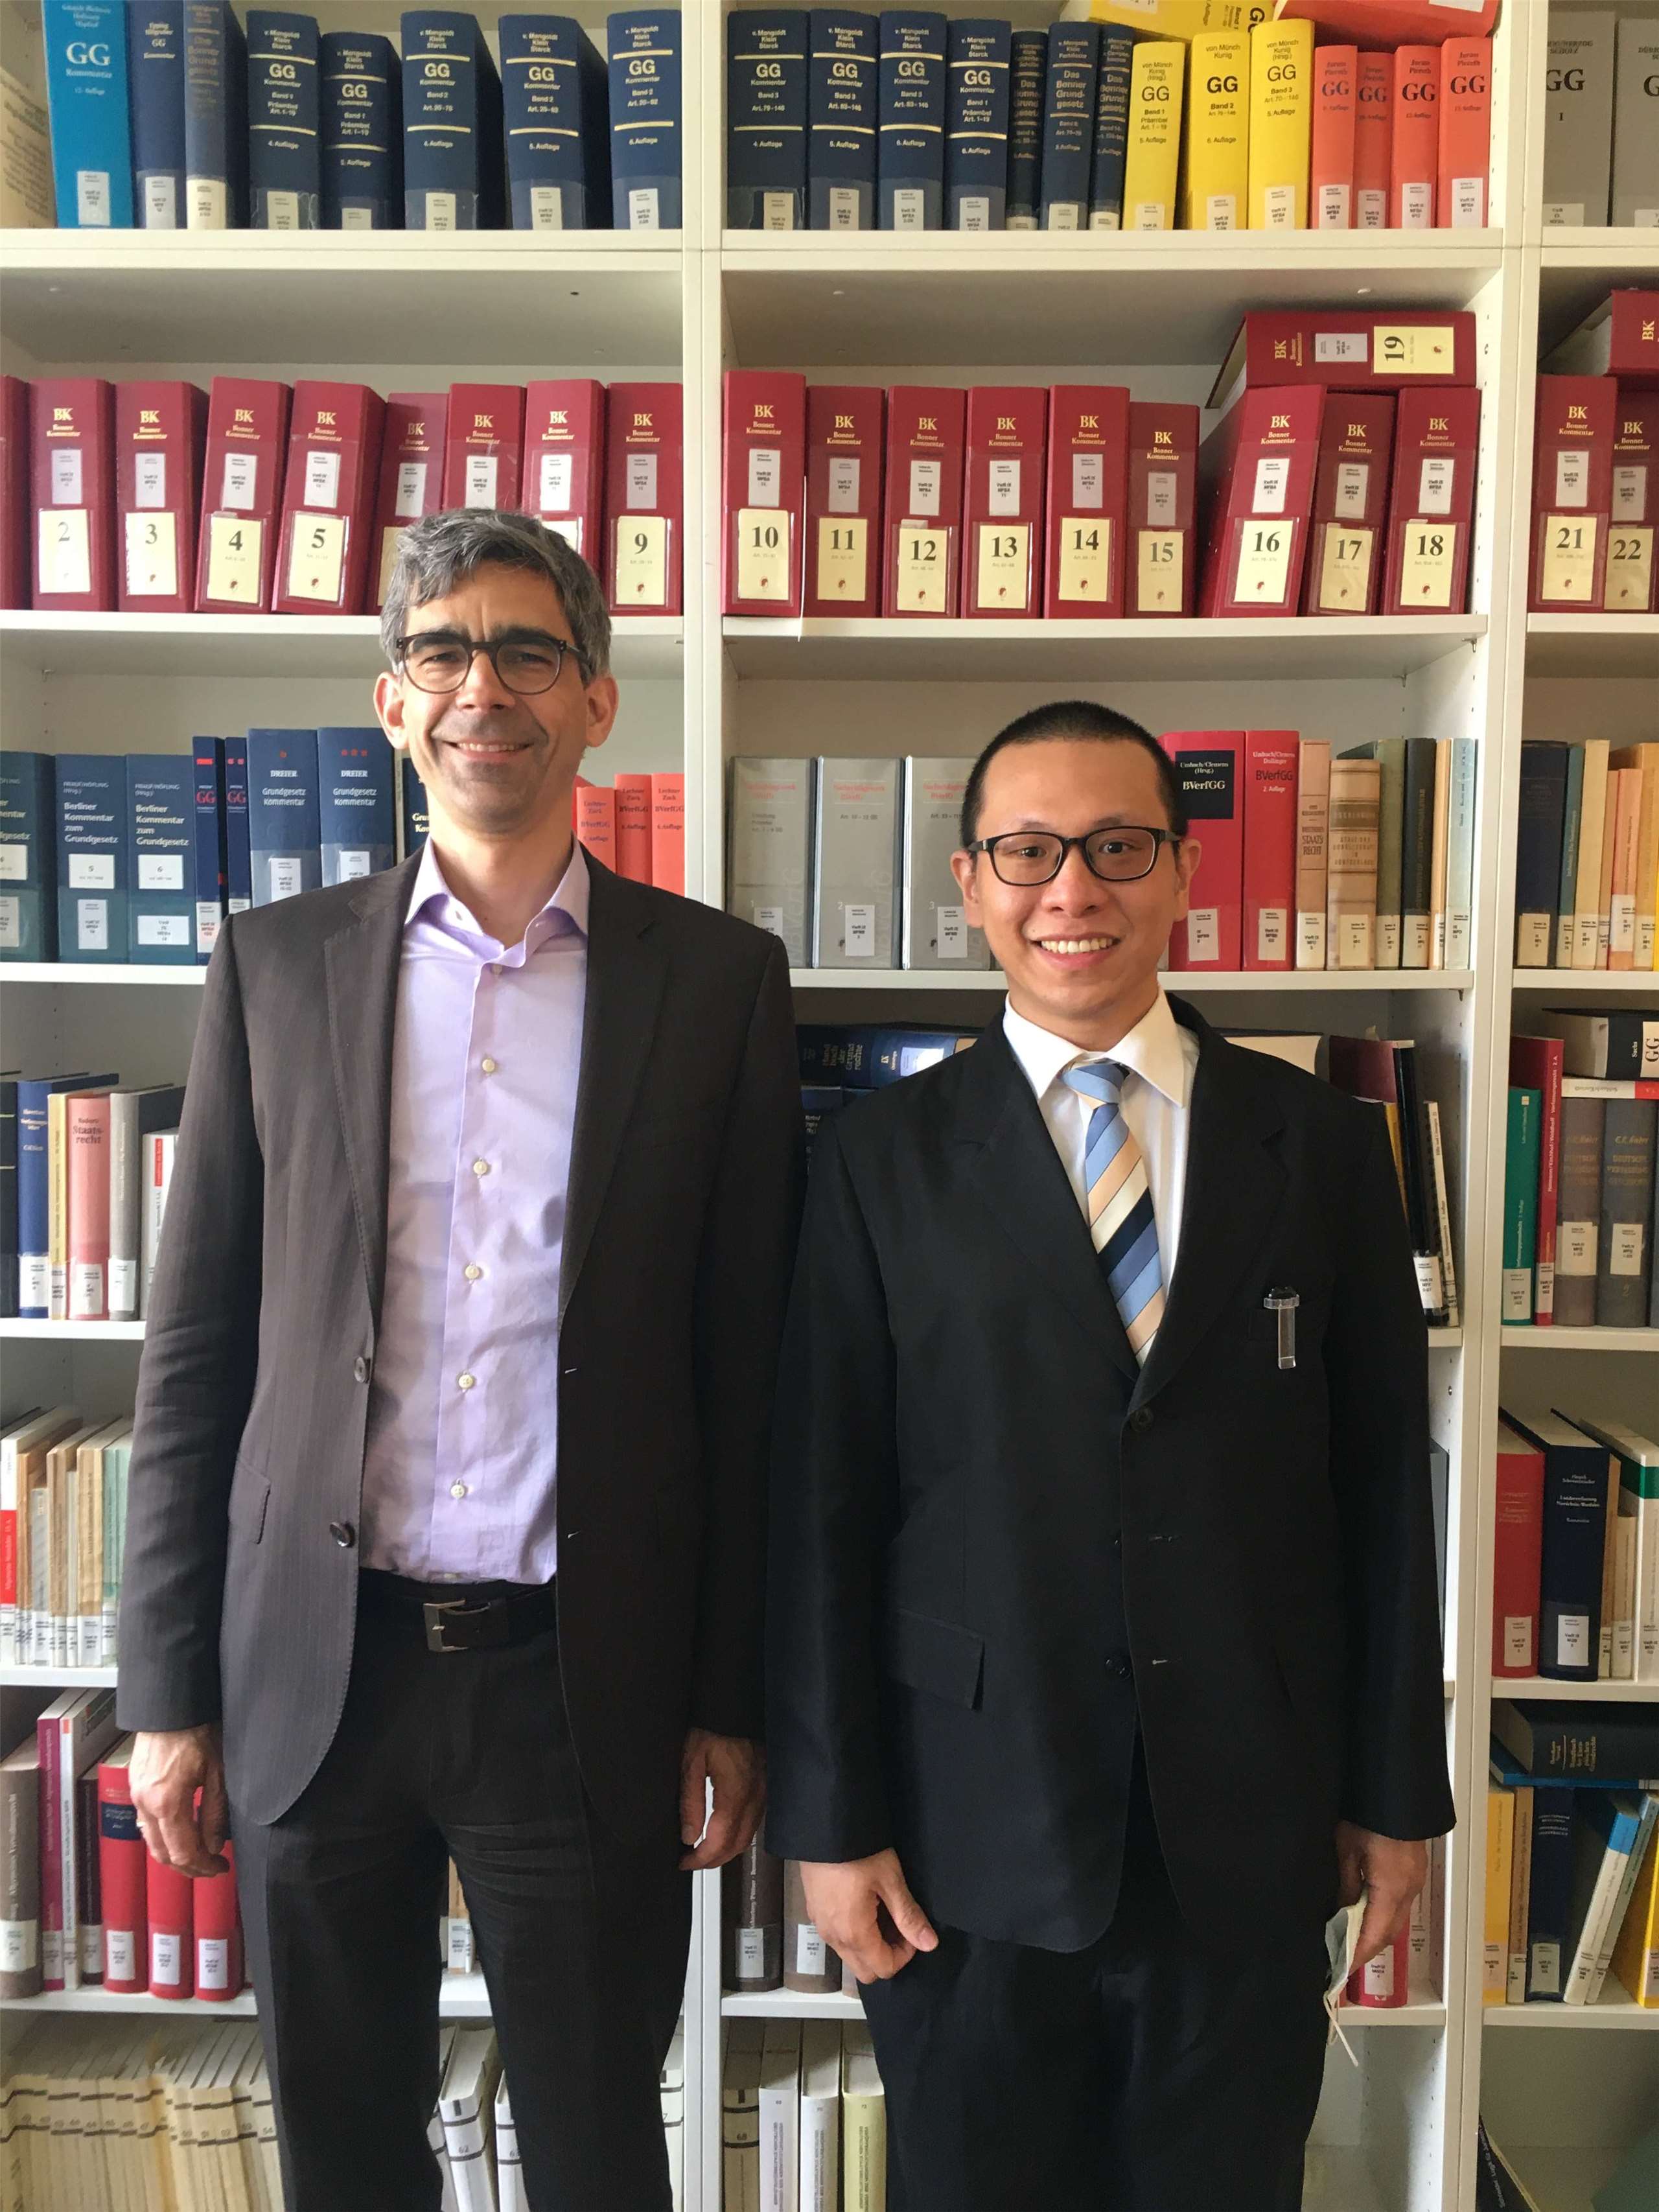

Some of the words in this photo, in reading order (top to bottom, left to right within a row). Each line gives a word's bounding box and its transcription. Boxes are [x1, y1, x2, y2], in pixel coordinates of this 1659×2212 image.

[151, 39, 167, 47] GG
[66, 41, 111, 66] GG
[269, 64, 296, 79] GG
[424, 63, 450, 78] GG
[528, 67, 555, 82] GG
[629, 60, 656, 75] GG
[756, 64, 782, 78] GG
[832, 63, 858, 78] GG
[898, 62, 925, 76] GG
[1063, 70, 1080, 78] Das
[1267, 64, 1296, 82] GG
[827, 78, 863, 87] Kommentar
[964, 70, 991, 85] GG
[1207, 76, 1238, 93] GG
[342, 84, 367, 99] GG
[1322, 80, 1349, 97] GG
[1450, 75, 1485, 95] GG
[1142, 86, 1170, 101] GG
[1358, 86, 1387, 102] GG
[1402, 83, 1436, 102] GG
[1642, 320, 1655, 341] BK
[1275, 340, 1286, 359] BK
[1384, 336, 1405, 362] 19
[52, 408, 73, 421] BK
[140, 410, 161, 423] BK
[234, 409, 255, 423] BK
[316, 411, 336, 425] BK
[549, 410, 569, 424] BK
[754, 404, 774, 418] BK
[1568, 406, 1588, 419] BK
[474, 414, 494, 428] BK
[633, 413, 653, 426] BK
[835, 415, 855, 428] BK
[918, 417, 938, 430] BK
[997, 417, 1016, 430] BK
[1080, 415, 1099, 428] BK
[1270, 415, 1290, 428] BK
[1429, 418, 1449, 430] BK
[407, 422, 425, 436] BK
[746, 427, 782, 436] Kommentar
[1347, 424, 1367, 437] BK
[1623, 421, 1643, 434] BK
[133, 432, 168, 440] Kommentar
[226, 432, 261, 440] Kommentar
[307, 433, 343, 442] Kommentar
[1154, 432, 1172, 444] BK
[1260, 437, 1297, 445] Kommentar
[58, 521, 70, 542] 2
[145, 523, 157, 544] 3
[312, 528, 325, 549] 5
[752, 526, 779, 548] 10
[1556, 527, 1584, 549] 21
[228, 530, 244, 552] 4
[634, 533, 648, 555] 9
[831, 529, 855, 551] 11
[1073, 529, 1099, 550] 14
[1253, 531, 1281, 552] 16
[1417, 535, 1444, 556] 18
[911, 540, 937, 562] 12
[992, 536, 1018, 558] 13
[1151, 542, 1174, 563] 15
[1336, 539, 1363, 560] 17
[1612, 539, 1642, 561] 22
[1256, 769, 1294, 782] BVerfGG
[262, 787, 306, 797] Grundgesetz
[333, 787, 377, 797] Grundgesetz
[1182, 780, 1225, 791] BVerfGG
[196, 791, 216, 804] GG
[227, 791, 246, 804] GG
[64, 802, 97, 811] Berliner
[135, 804, 168, 813] Berliner
[64, 813, 115, 823] Kommentar
[135, 816, 185, 825] Kommentar
[65, 835, 119, 844] Grundgesetz
[136, 837, 189, 847] Grundgesetz
[1645, 1038, 1659, 1063] GG
[73, 1126, 104, 1135] Staats-
[76, 1135, 101, 1144] recht
